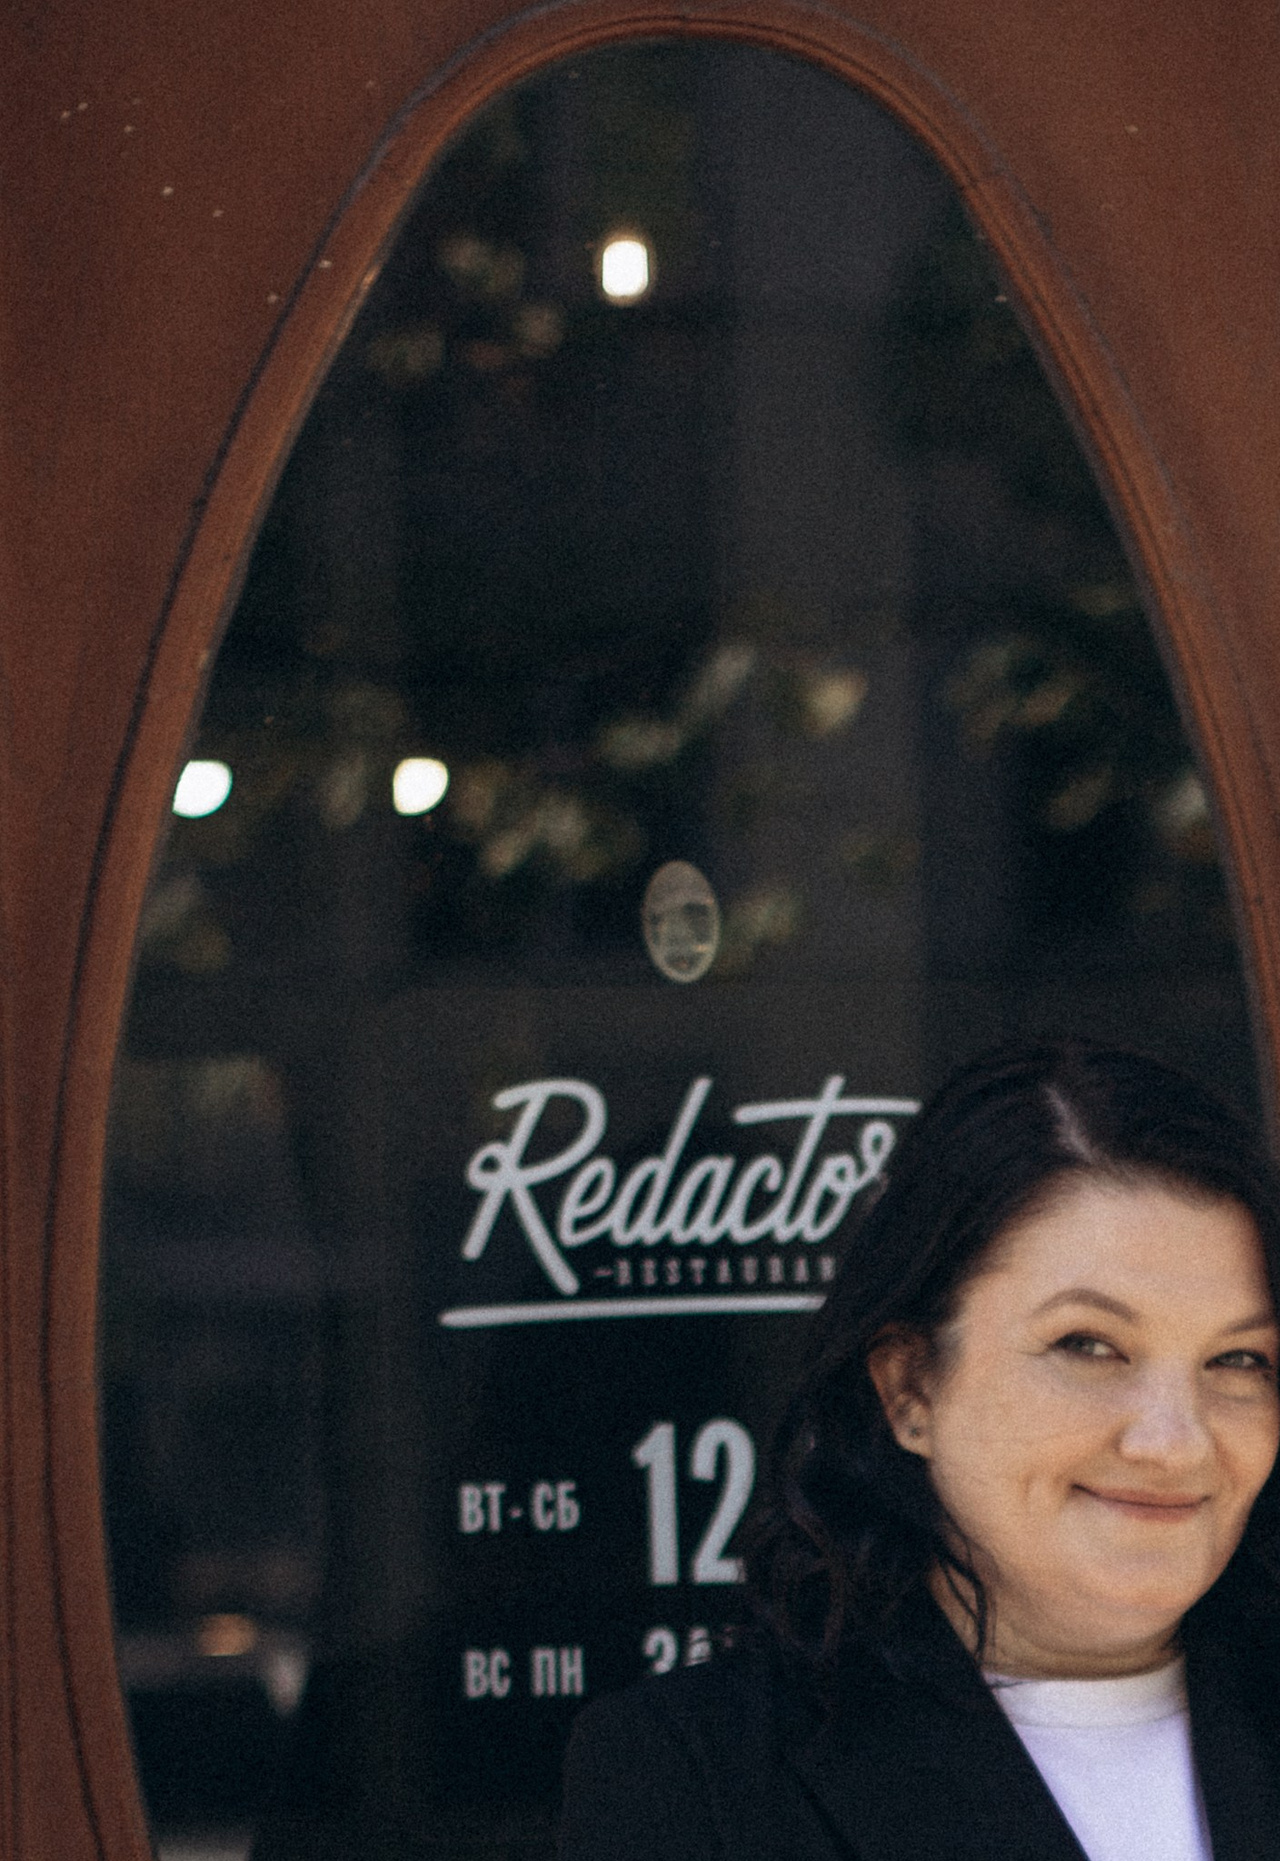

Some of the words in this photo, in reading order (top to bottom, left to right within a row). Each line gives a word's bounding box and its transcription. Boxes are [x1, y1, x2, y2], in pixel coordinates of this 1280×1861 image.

[461, 1074, 921, 1296] Redacto
[630, 1415, 757, 1587] 12
[463, 1645, 512, 1700] ВС
[529, 1644, 586, 1698] ПН
